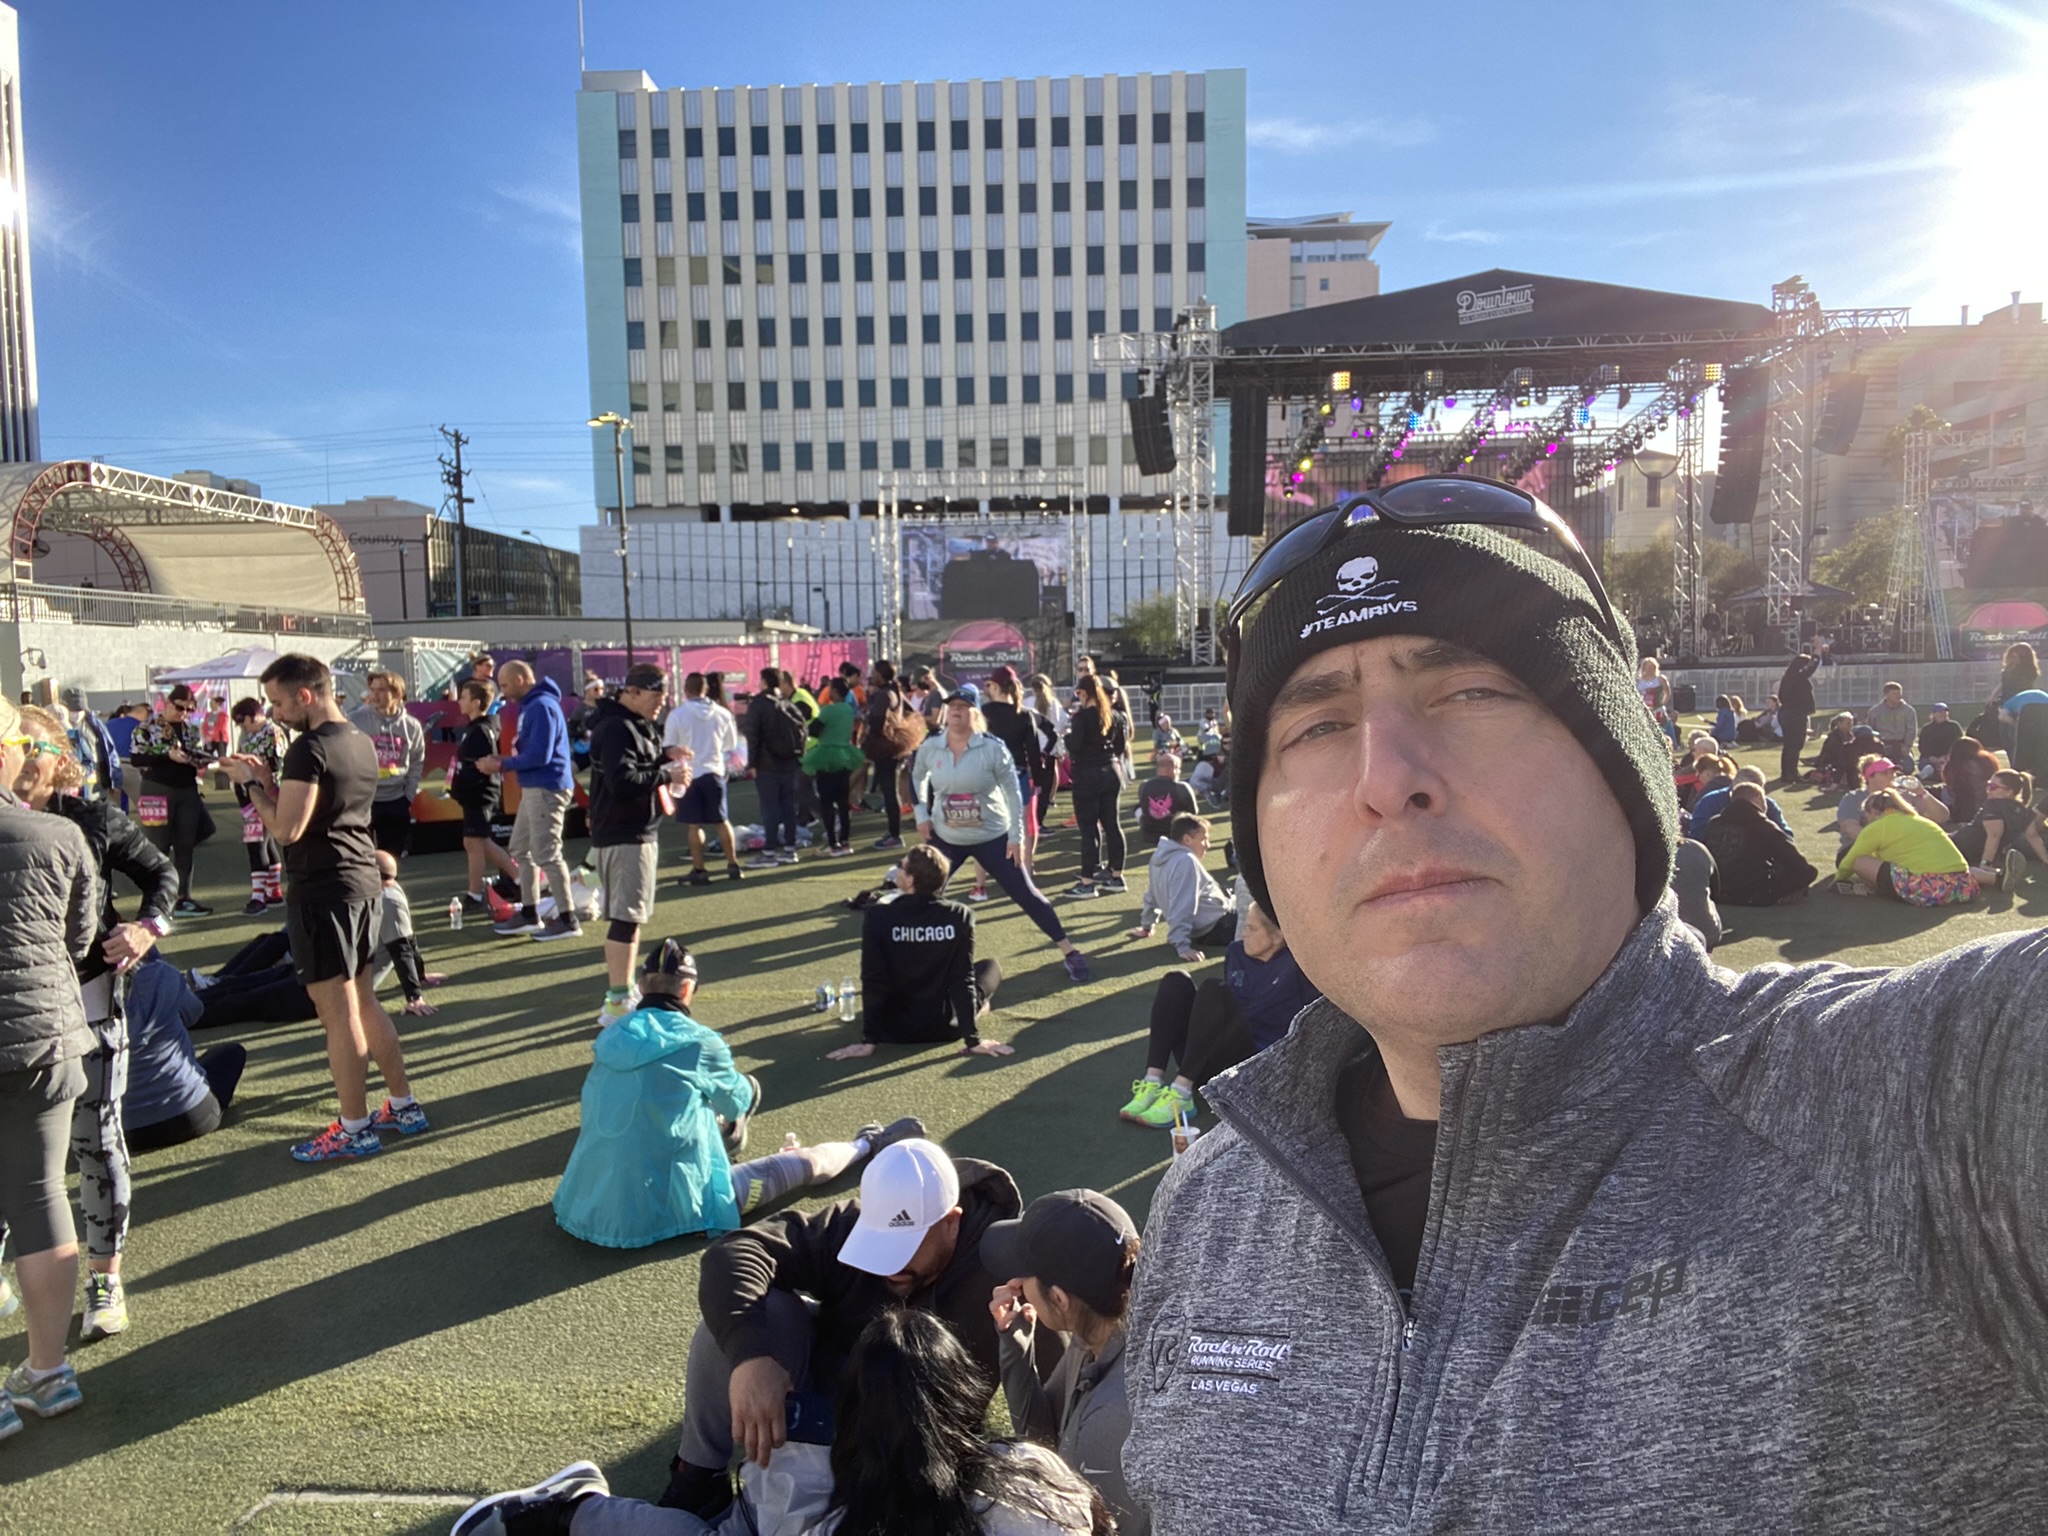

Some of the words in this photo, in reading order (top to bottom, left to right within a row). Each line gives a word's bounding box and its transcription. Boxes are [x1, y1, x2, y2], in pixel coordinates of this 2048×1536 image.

[1457, 284, 1534, 314] Downtown
[348, 532, 400, 547] County
[1300, 600, 1418, 639] #TEAMRIVS
[892, 925, 955, 942] CHICAGO
[888, 1220, 915, 1228] adidas
[1190, 1356, 1233, 1367] RUNNING
[1234, 1357, 1274, 1371] SERIES
[1191, 1379, 1213, 1391] LAS
[1215, 1380, 1259, 1394] VEGAS
